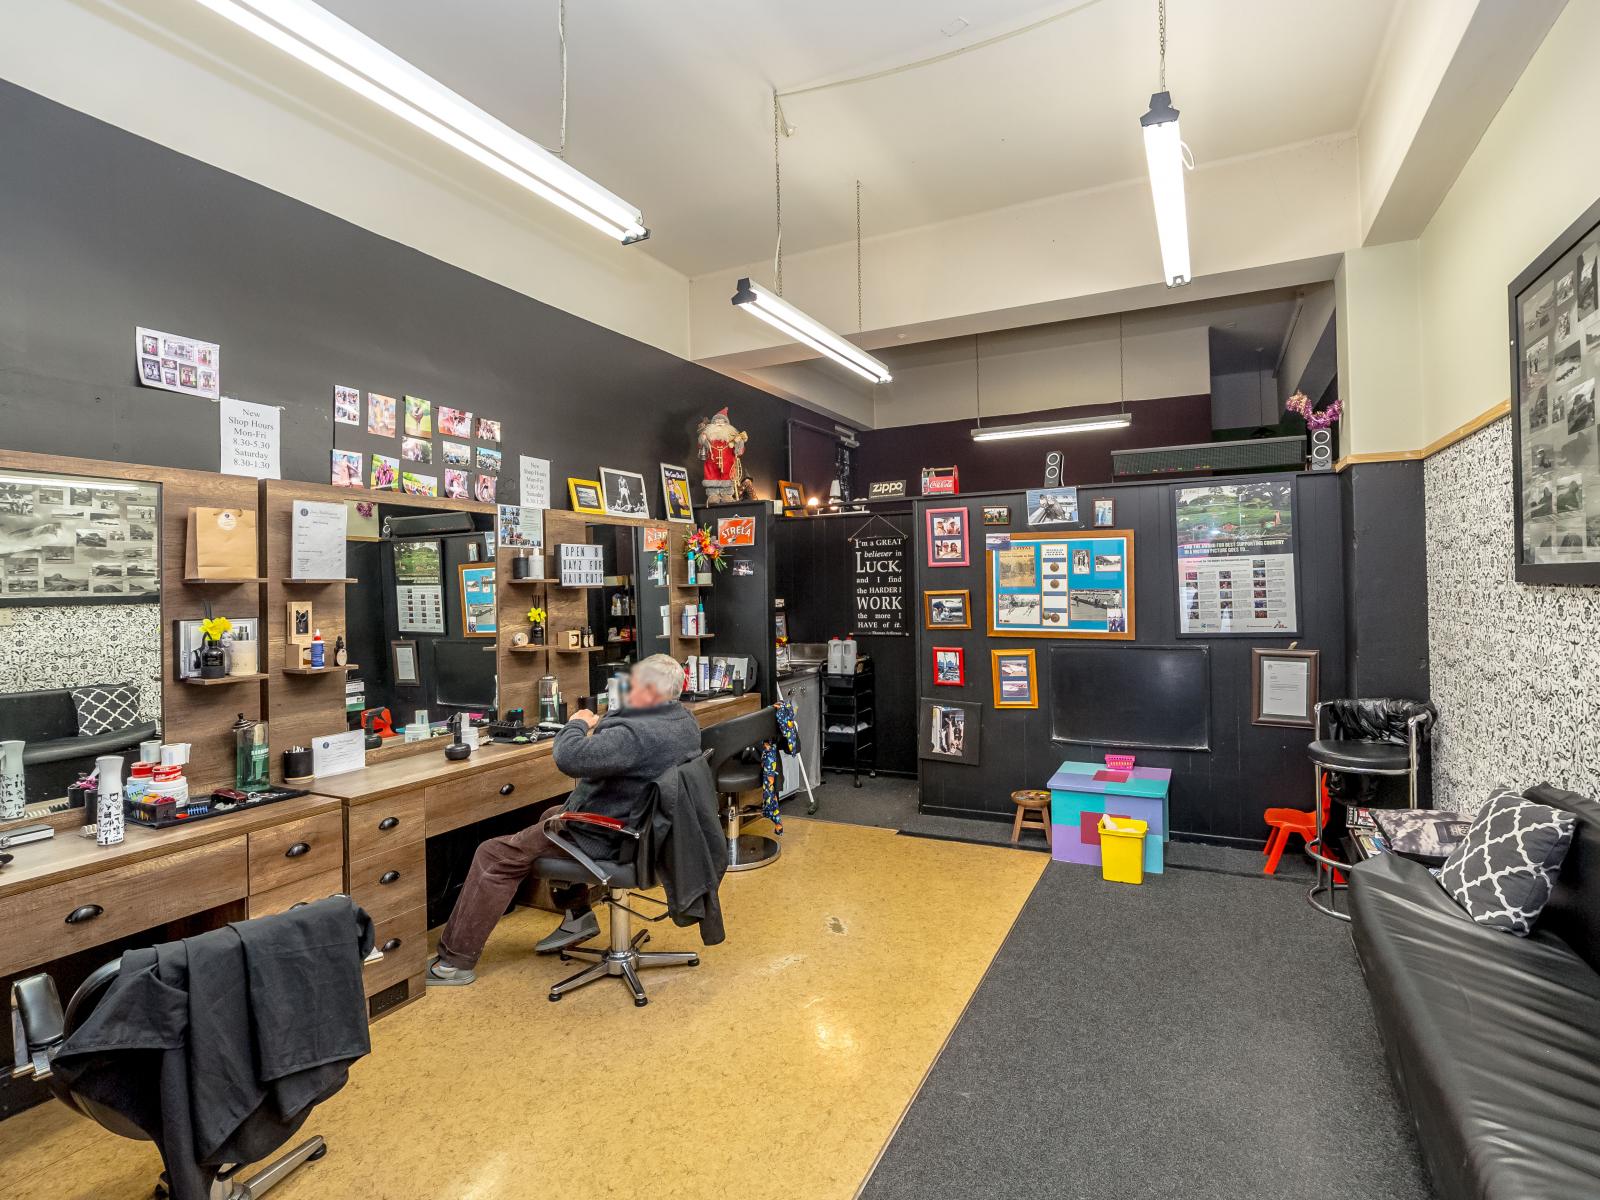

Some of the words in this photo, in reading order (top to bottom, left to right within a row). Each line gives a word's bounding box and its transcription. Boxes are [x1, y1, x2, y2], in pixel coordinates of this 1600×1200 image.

[242, 408, 261, 418] New
[228, 416, 249, 428] Shop
[251, 420, 274, 430] Hours
[234, 427, 267, 439] Mon-Fri
[233, 437, 271, 449] 8.30-5.30
[234, 448, 269, 460] Saturday
[233, 458, 271, 469] 8.30-1.30
[872, 482, 903, 494] zippo
[721, 526, 751, 538] STRELA
[855, 539, 868, 548] I'm
[566, 546, 584, 556] OPEN
[563, 560, 582, 570] DAYZ
[590, 560, 602, 570] FOR
[856, 552, 902, 573] LUCK,
[563, 574, 581, 583] HAIR
[586, 574, 602, 583] CUTS
[856, 596, 902, 610] WORK
